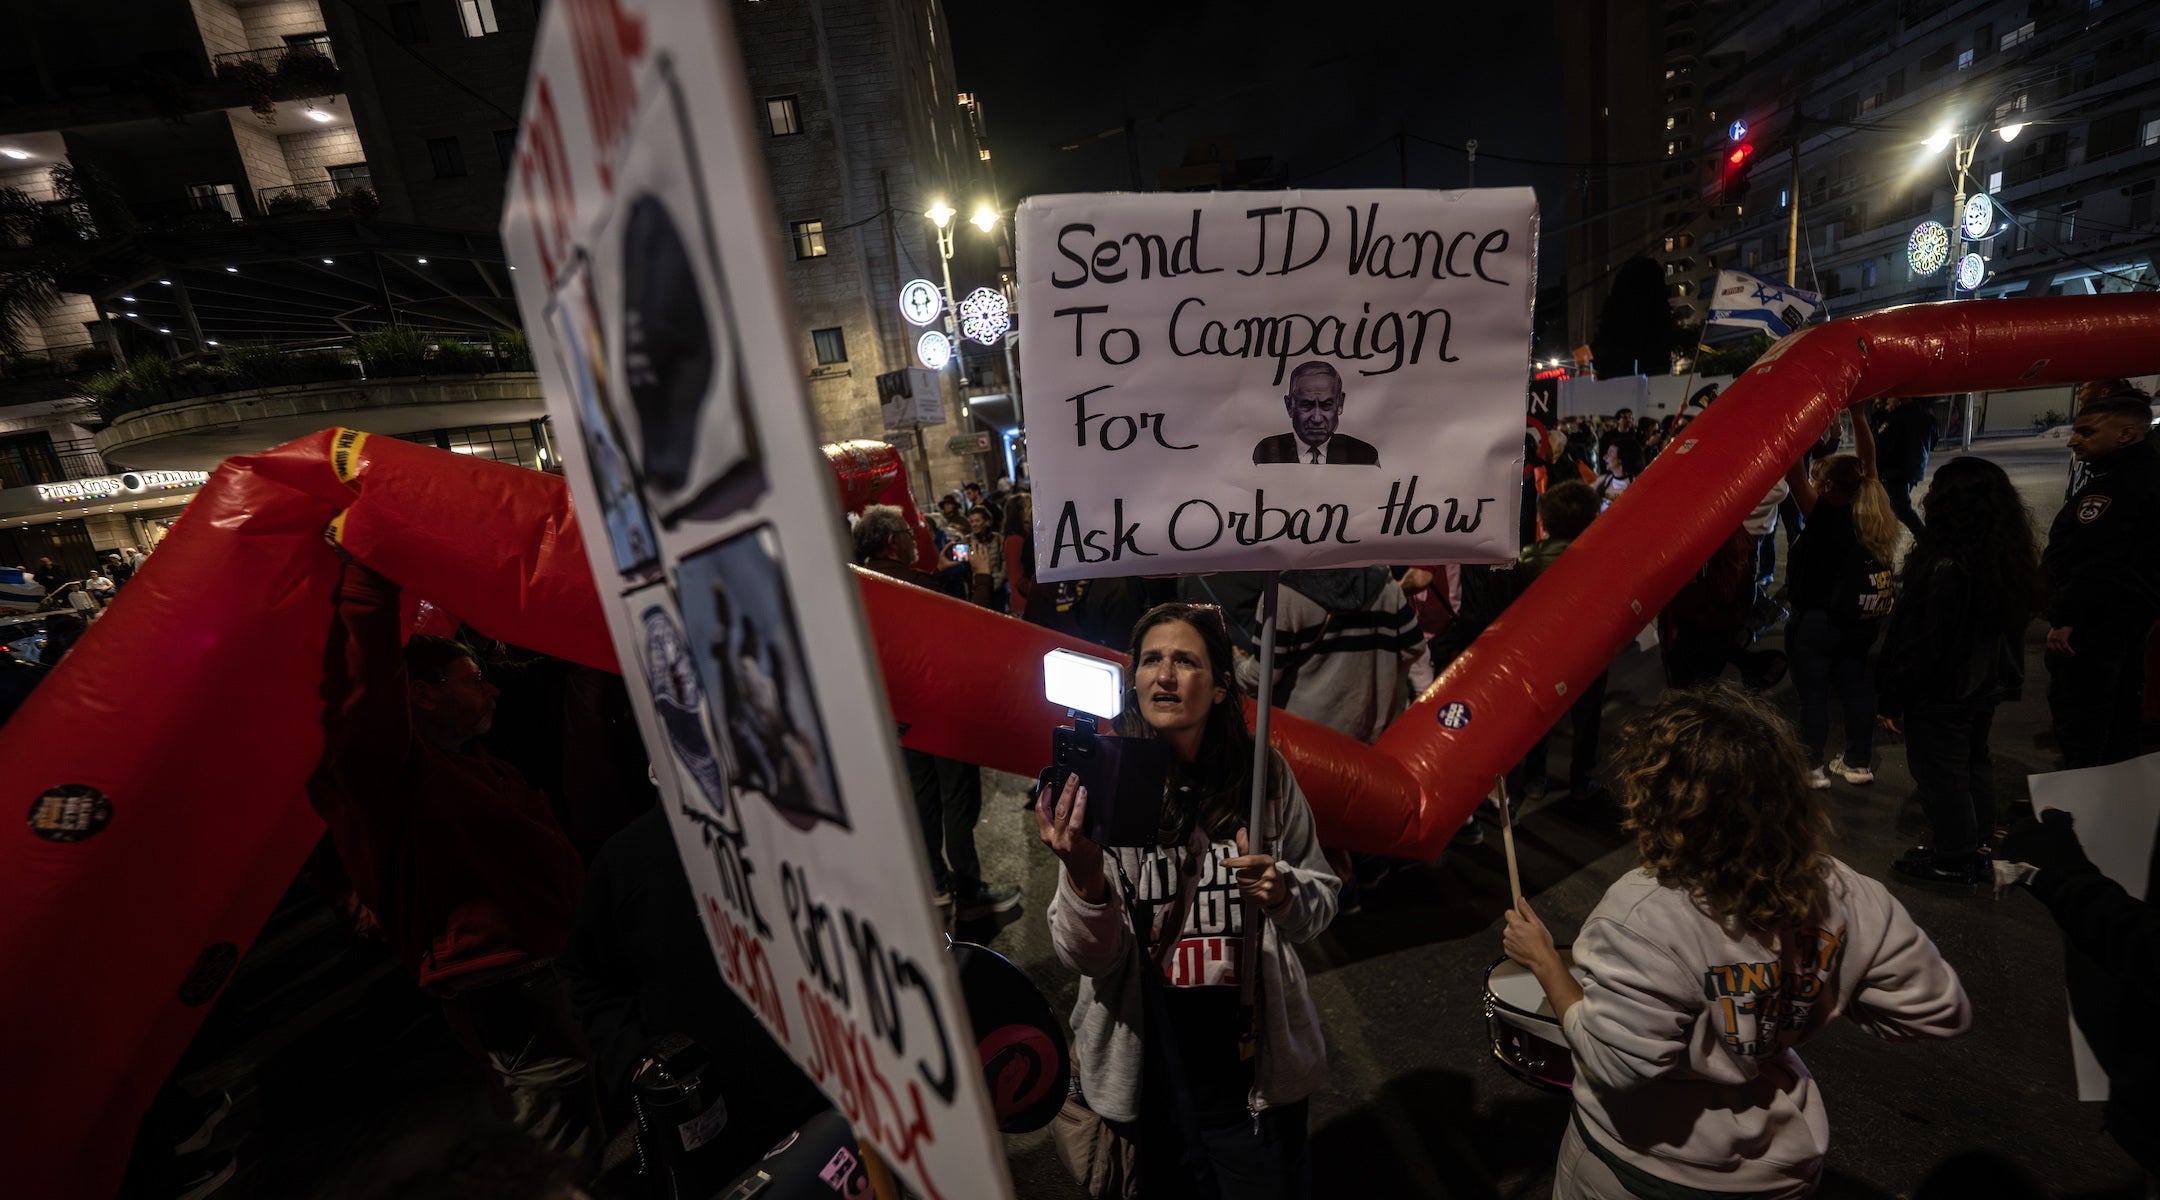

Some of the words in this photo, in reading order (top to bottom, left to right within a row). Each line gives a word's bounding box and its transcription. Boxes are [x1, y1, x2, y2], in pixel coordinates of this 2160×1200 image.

[1051, 208, 1224, 290] Send
[1236, 205, 1330, 277] JD
[1346, 202, 1511, 286] Vance
[1053, 304, 1141, 366] To
[1168, 297, 1460, 386] Campaign
[1065, 384, 1200, 451] For
[36, 484, 80, 500] Prima
[79, 478, 121, 494] Kings
[1049, 498, 1159, 569] Ask
[1168, 488, 1361, 552] Orban
[1377, 475, 1496, 538] How
